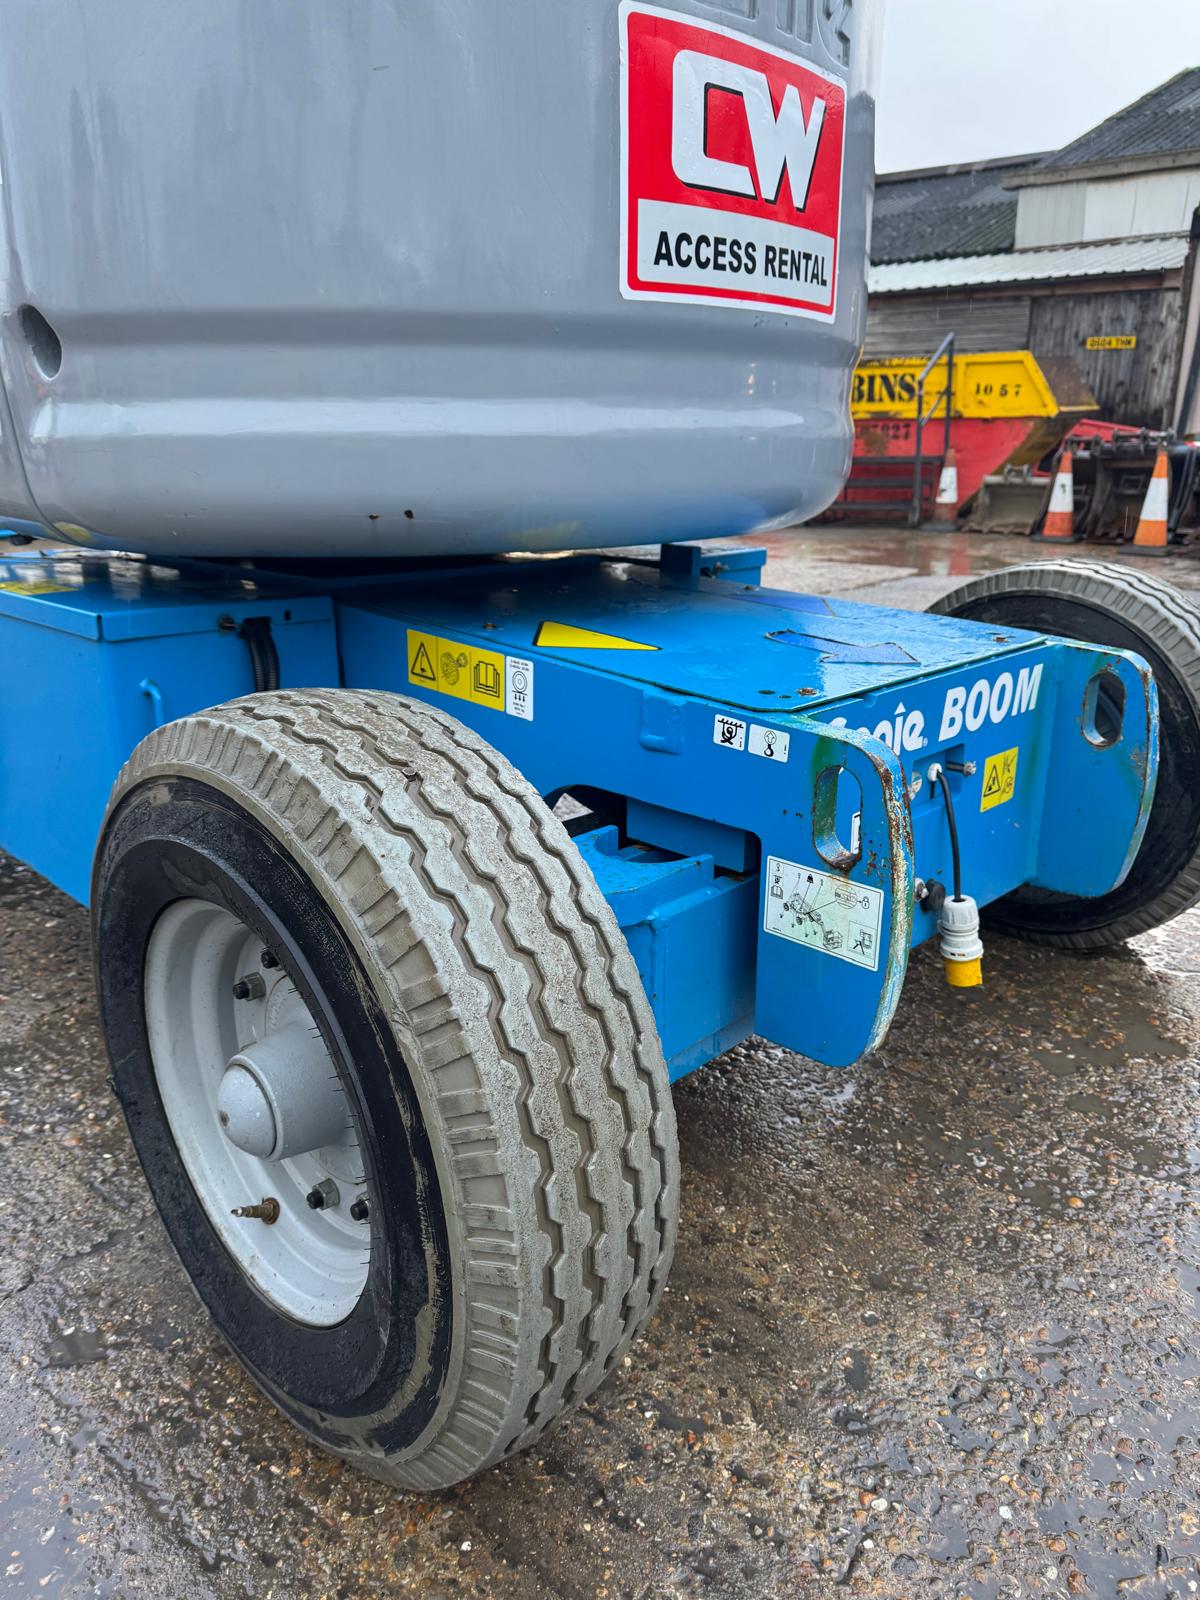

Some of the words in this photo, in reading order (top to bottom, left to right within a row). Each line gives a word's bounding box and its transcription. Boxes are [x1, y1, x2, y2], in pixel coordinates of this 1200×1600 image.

[671, 49, 827, 213] CW
[653, 231, 757, 275] ACCESS
[764, 245, 827, 287] RENTAL
[829, 702, 925, 756] nie
[938, 663, 1044, 742] BOOM
